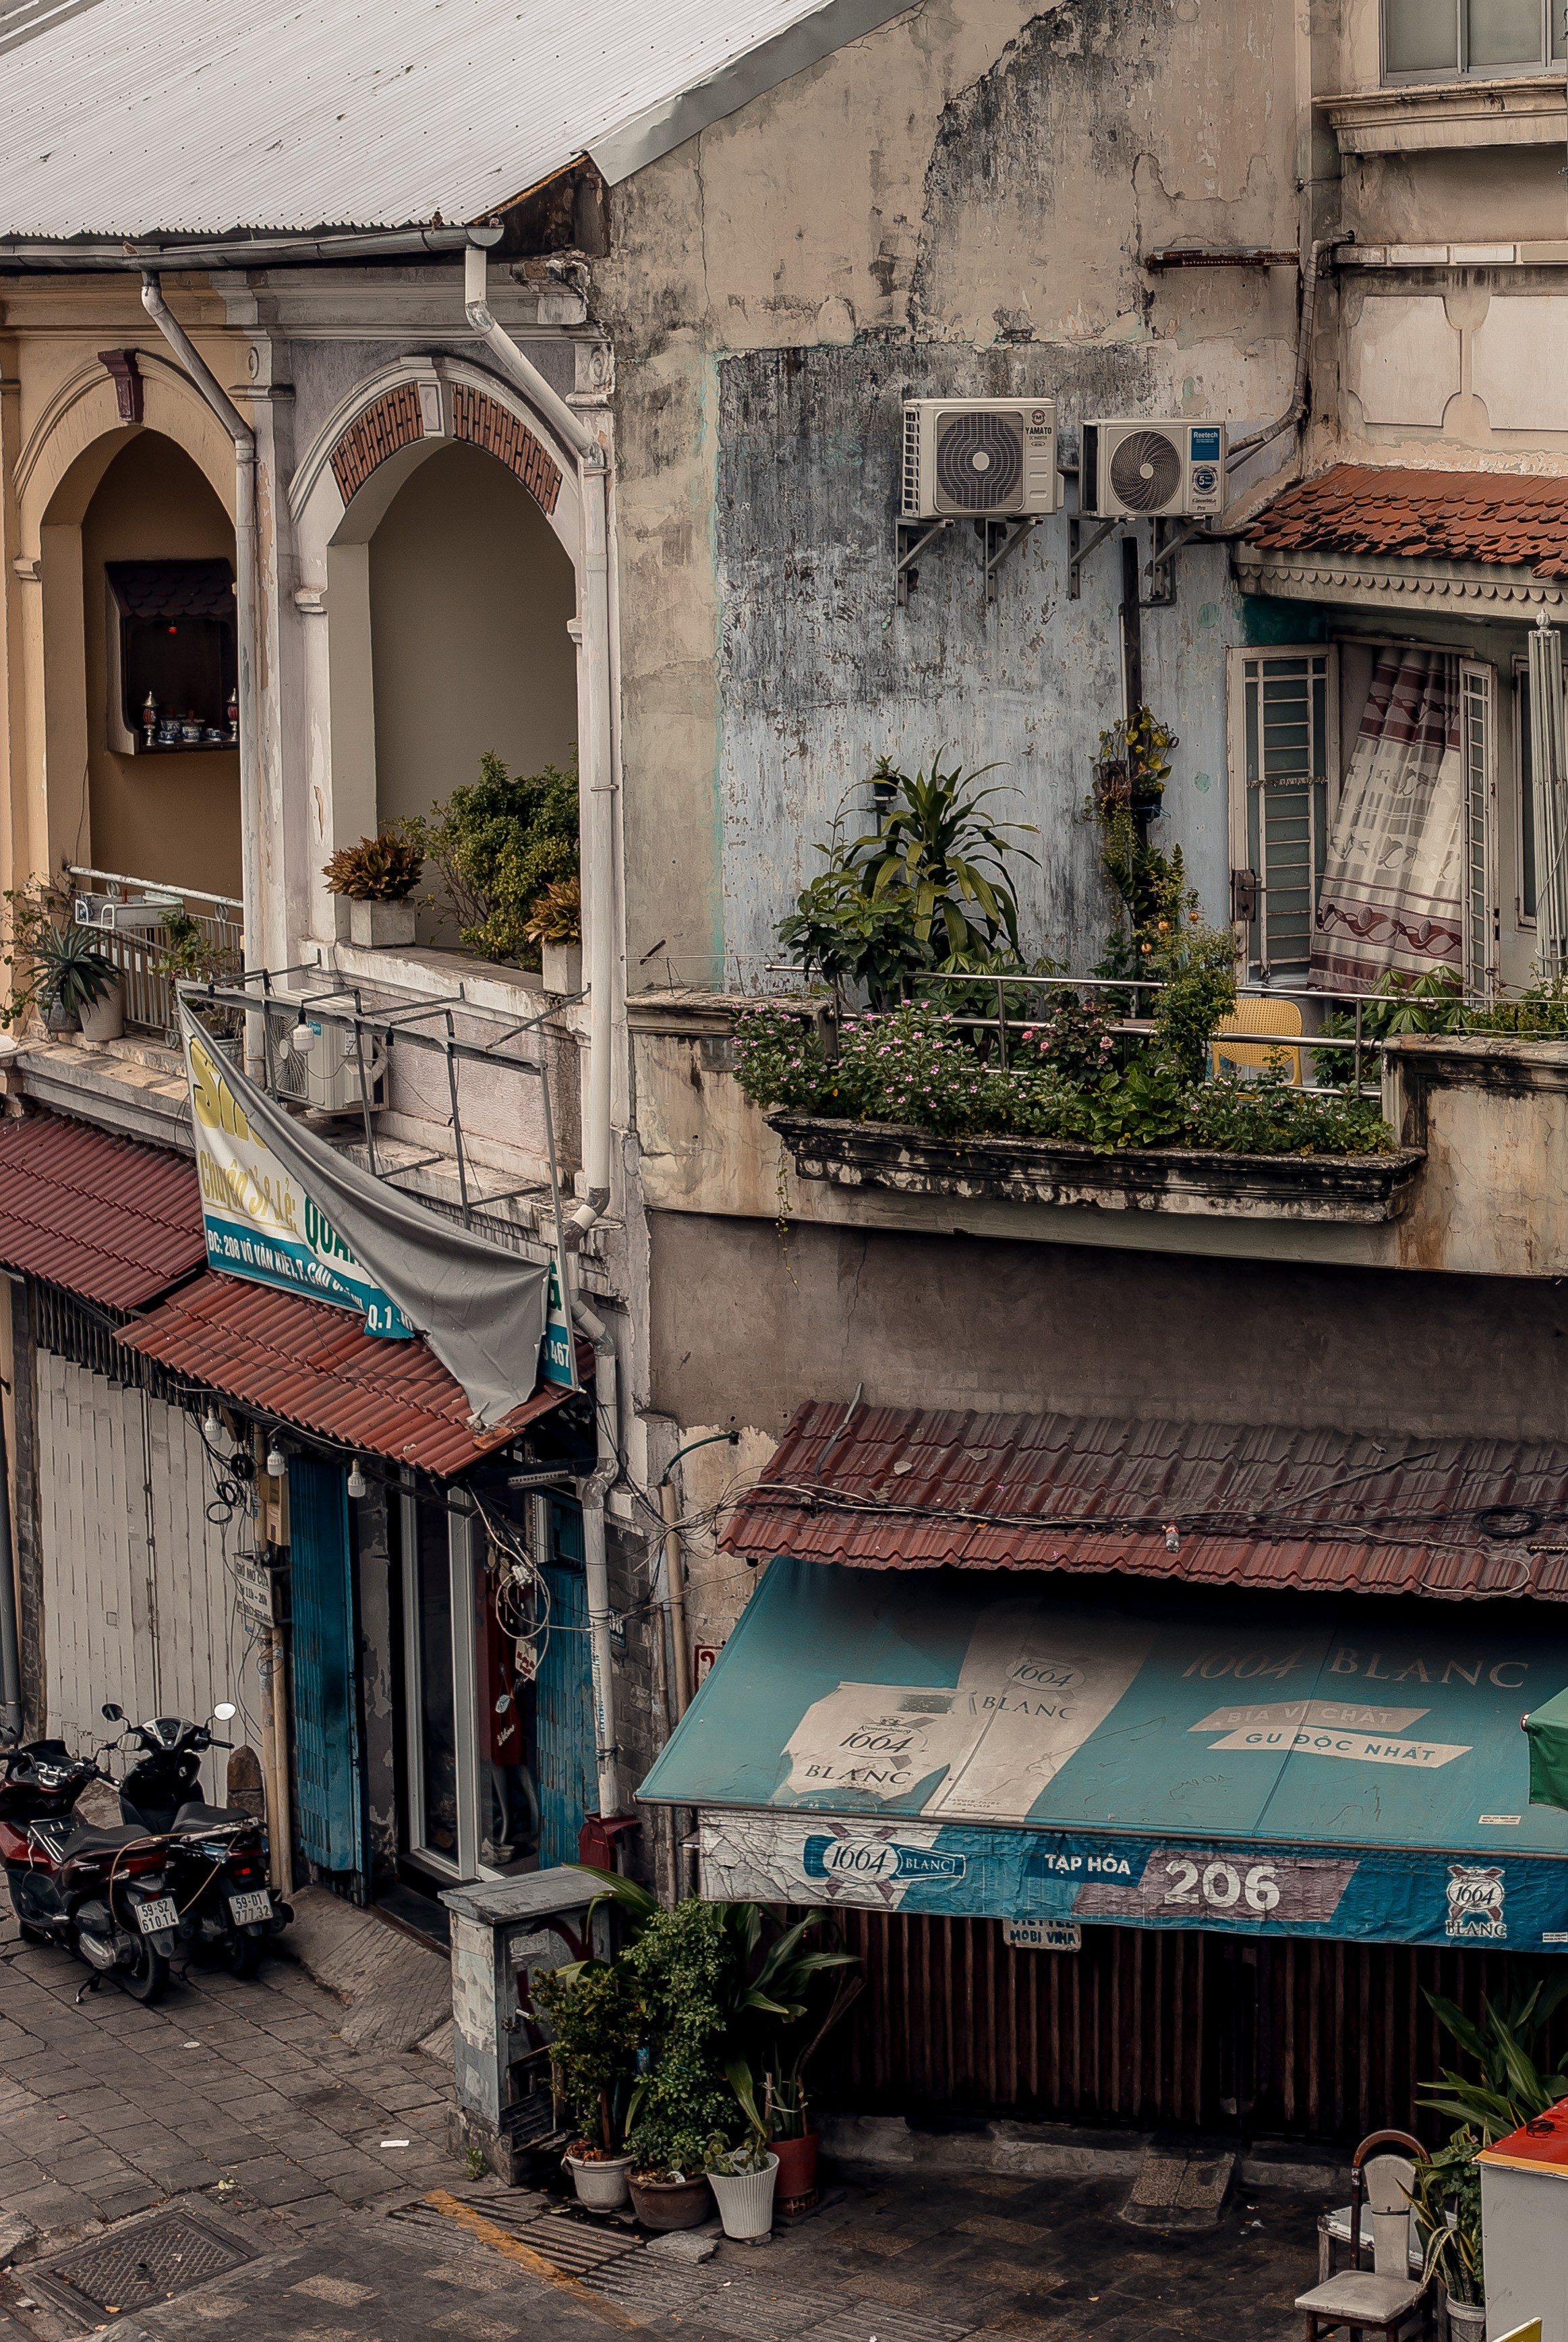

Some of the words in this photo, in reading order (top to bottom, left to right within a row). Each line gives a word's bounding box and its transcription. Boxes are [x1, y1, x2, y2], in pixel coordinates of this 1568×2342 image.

[1025, 426, 1052, 435] YAMATO
[1198, 476, 1205, 486] 5
[223, 1234, 240, 1260] 208
[254, 1241, 275, 1271] VĂN
[550, 1340, 570, 1368] 467
[1012, 1663, 1074, 1688] 1664
[1327, 1647, 1530, 1688] BLANC
[981, 1696, 1078, 1720] BLANC
[1227, 1709, 1270, 1723] BIA
[858, 1725, 912, 1734] Kronenbourg
[838, 1731, 914, 1753] 1664
[1245, 1733, 1283, 1744] GU
[1293, 1733, 1354, 1751] ĐỘC
[1364, 1744, 1436, 1761] NHẤT
[804, 1764, 914, 1785] BLANC
[832, 1842, 891, 1874] 1664
[906, 1858, 951, 1872] BLANC
[1044, 1854, 1082, 1875] TẠP
[1088, 1852, 1131, 1875] HÓA
[1164, 1859, 1280, 1912] 206
[1455, 1885, 1497, 1905] 1664
[141, 1900, 170, 1918] 59-S2
[142, 1912, 176, 1932] 610.14
[1446, 1920, 1507, 1939] BLANC
[1010, 1929, 1042, 1943] MOBI
